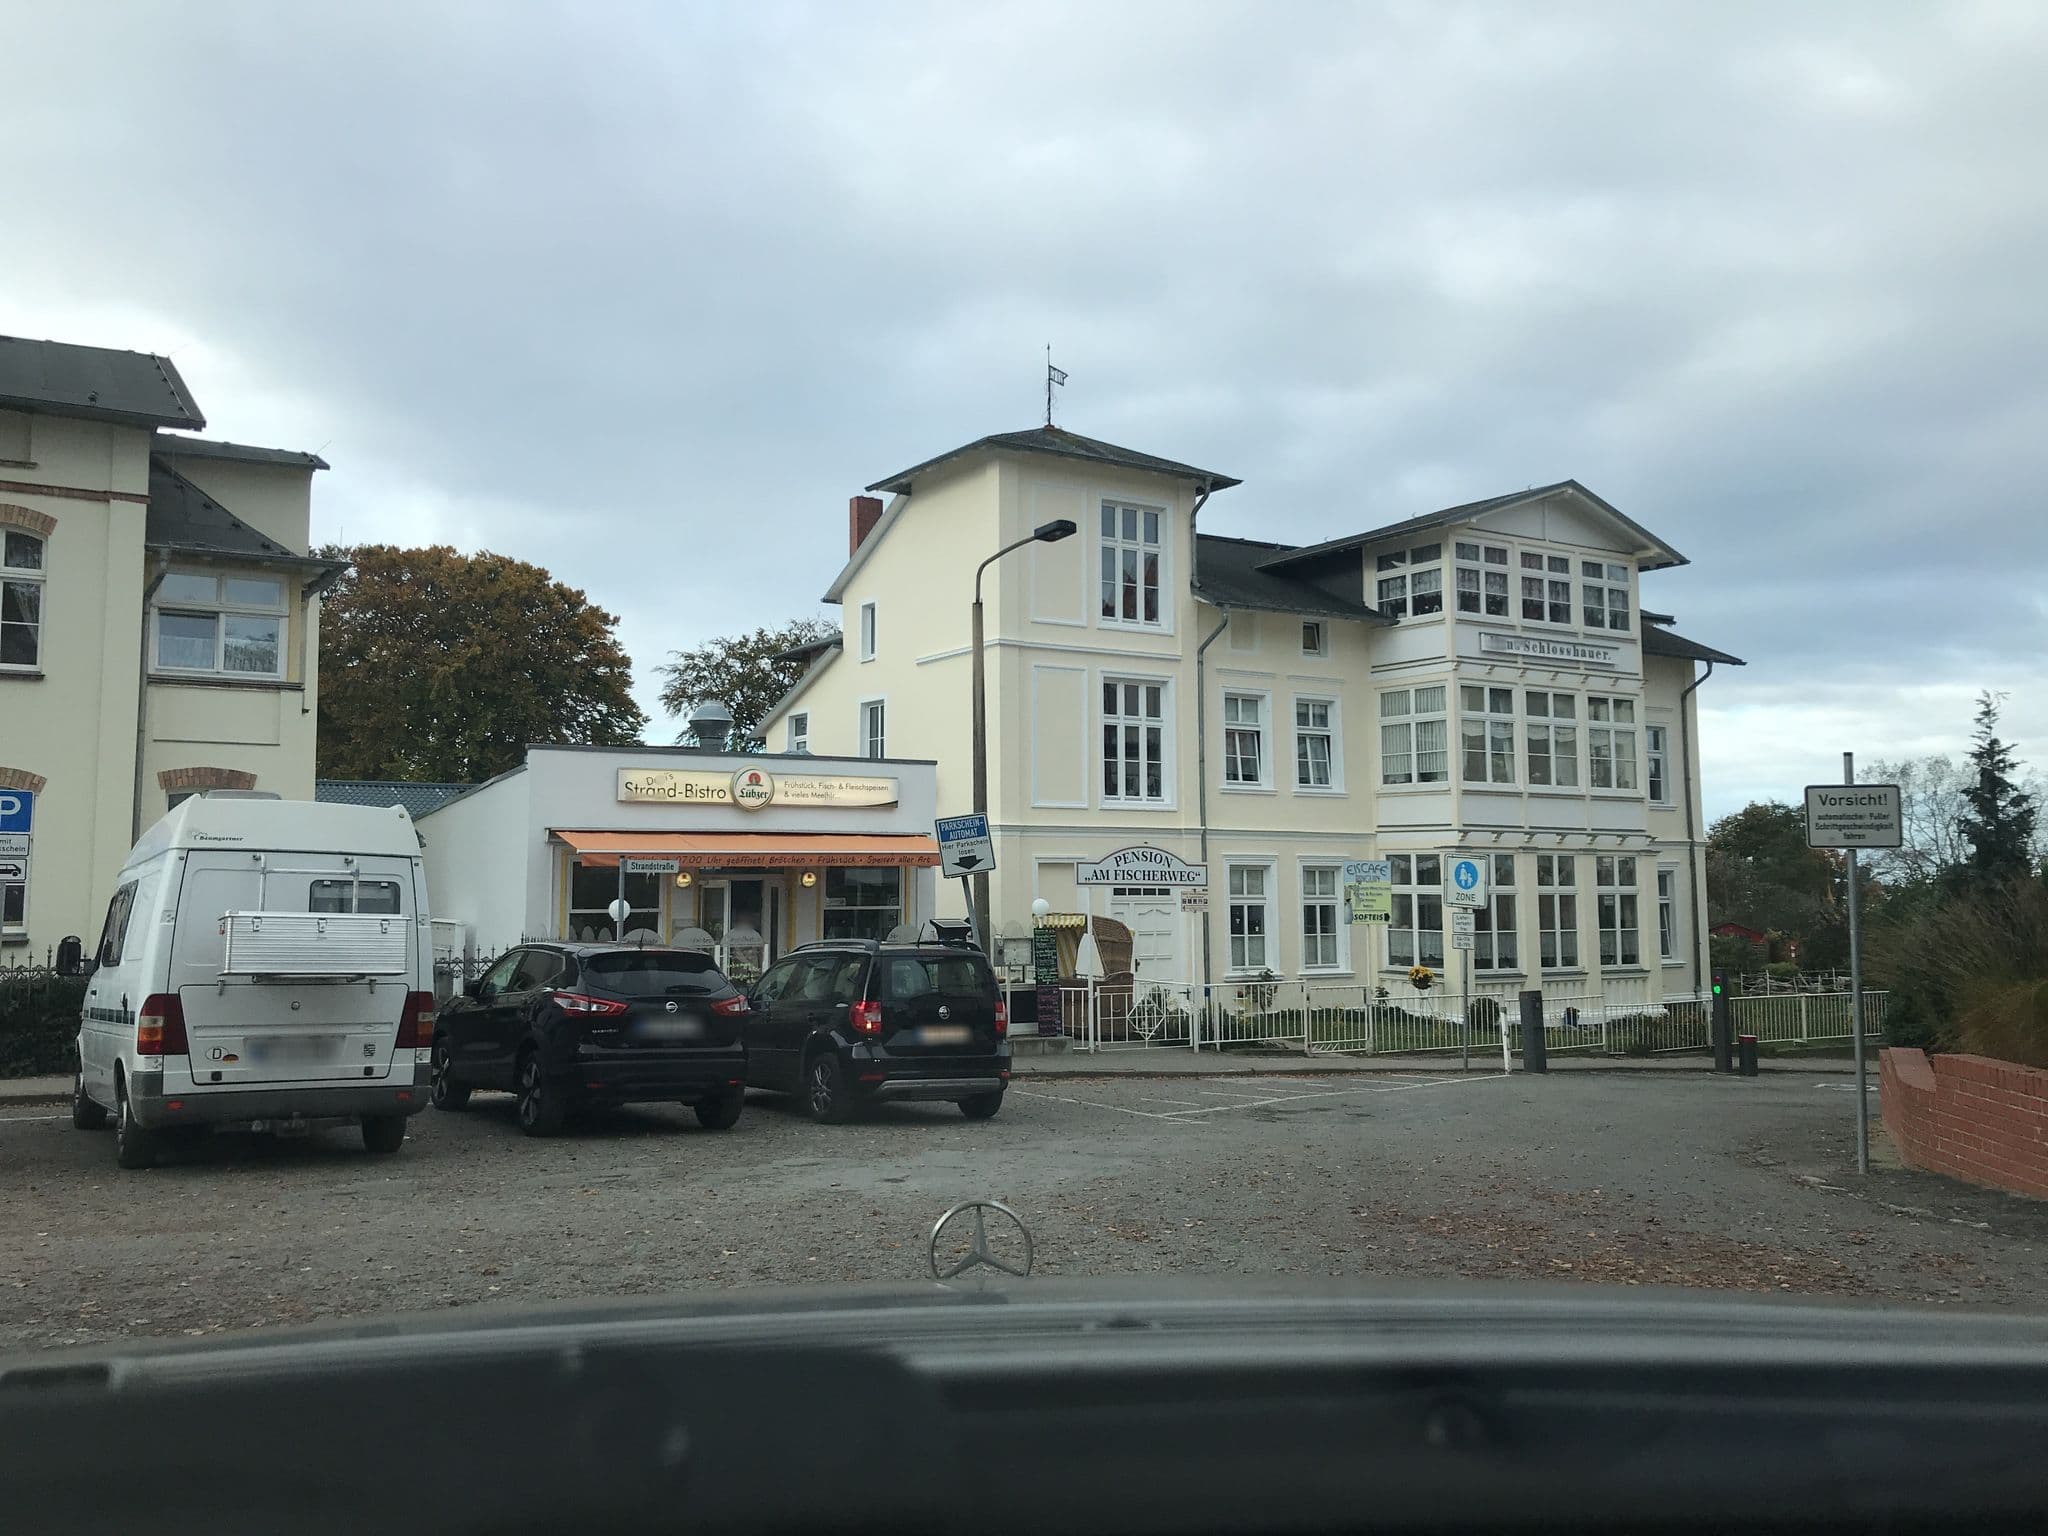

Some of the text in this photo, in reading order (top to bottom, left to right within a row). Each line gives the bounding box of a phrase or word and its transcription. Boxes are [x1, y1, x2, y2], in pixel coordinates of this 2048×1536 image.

[624, 781, 727, 799] Strand-Bistro
[738, 787, 769, 799] Lübzer
[1818, 793, 1888, 806] Vorsicht!
[0, 795, 21, 828] P
[940, 818, 984, 832] PARKSCHEIN-
[949, 828, 978, 840] AUTOMAT
[1114, 850, 1174, 869] PENSION
[631, 861, 675, 871] Strandstraße
[1455, 892, 1476, 902] ZONE
[1354, 913, 1384, 921] SOFTEIS
[212, 1048, 221, 1060] D
